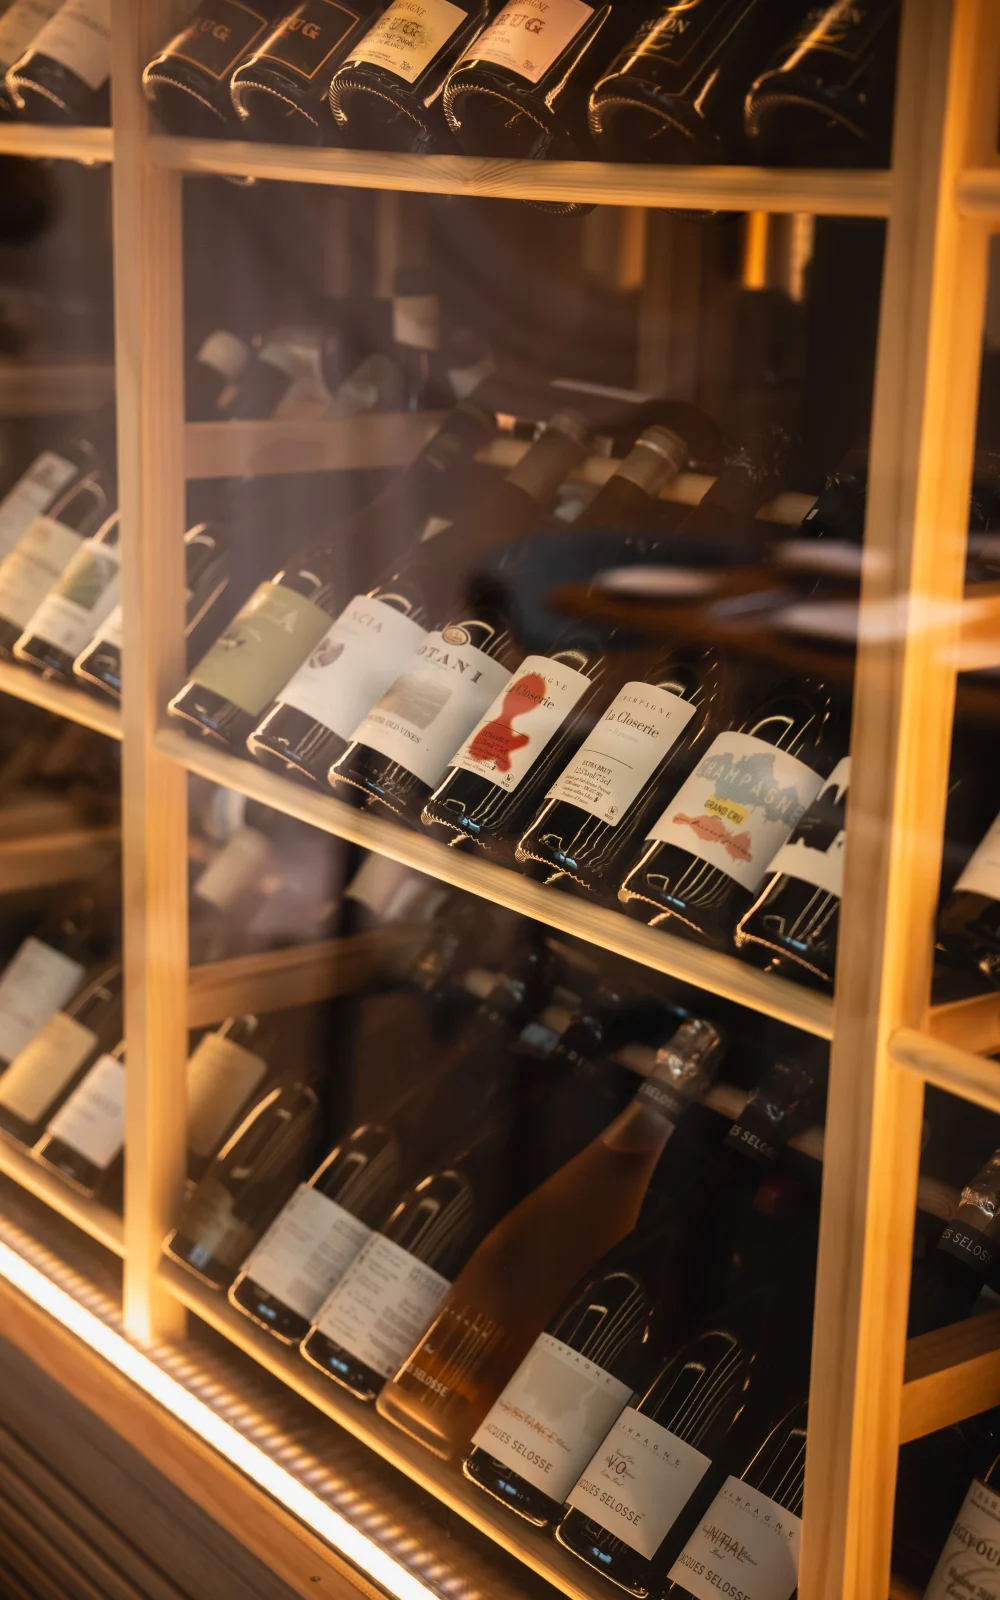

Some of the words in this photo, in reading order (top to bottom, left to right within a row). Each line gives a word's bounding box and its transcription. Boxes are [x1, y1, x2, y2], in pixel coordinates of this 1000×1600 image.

[515, 684, 555, 710] Closerie
[398, 726, 422, 745] VINES
[616, 711, 660, 739] Closerie
[696, 757, 807, 828] CHAMPAGNE
[704, 799, 728, 817] GRAND
[726, 810, 744, 825] CRU
[510, 1438, 554, 1474] SELOSSE
[599, 1491, 642, 1527] SELOSSE
